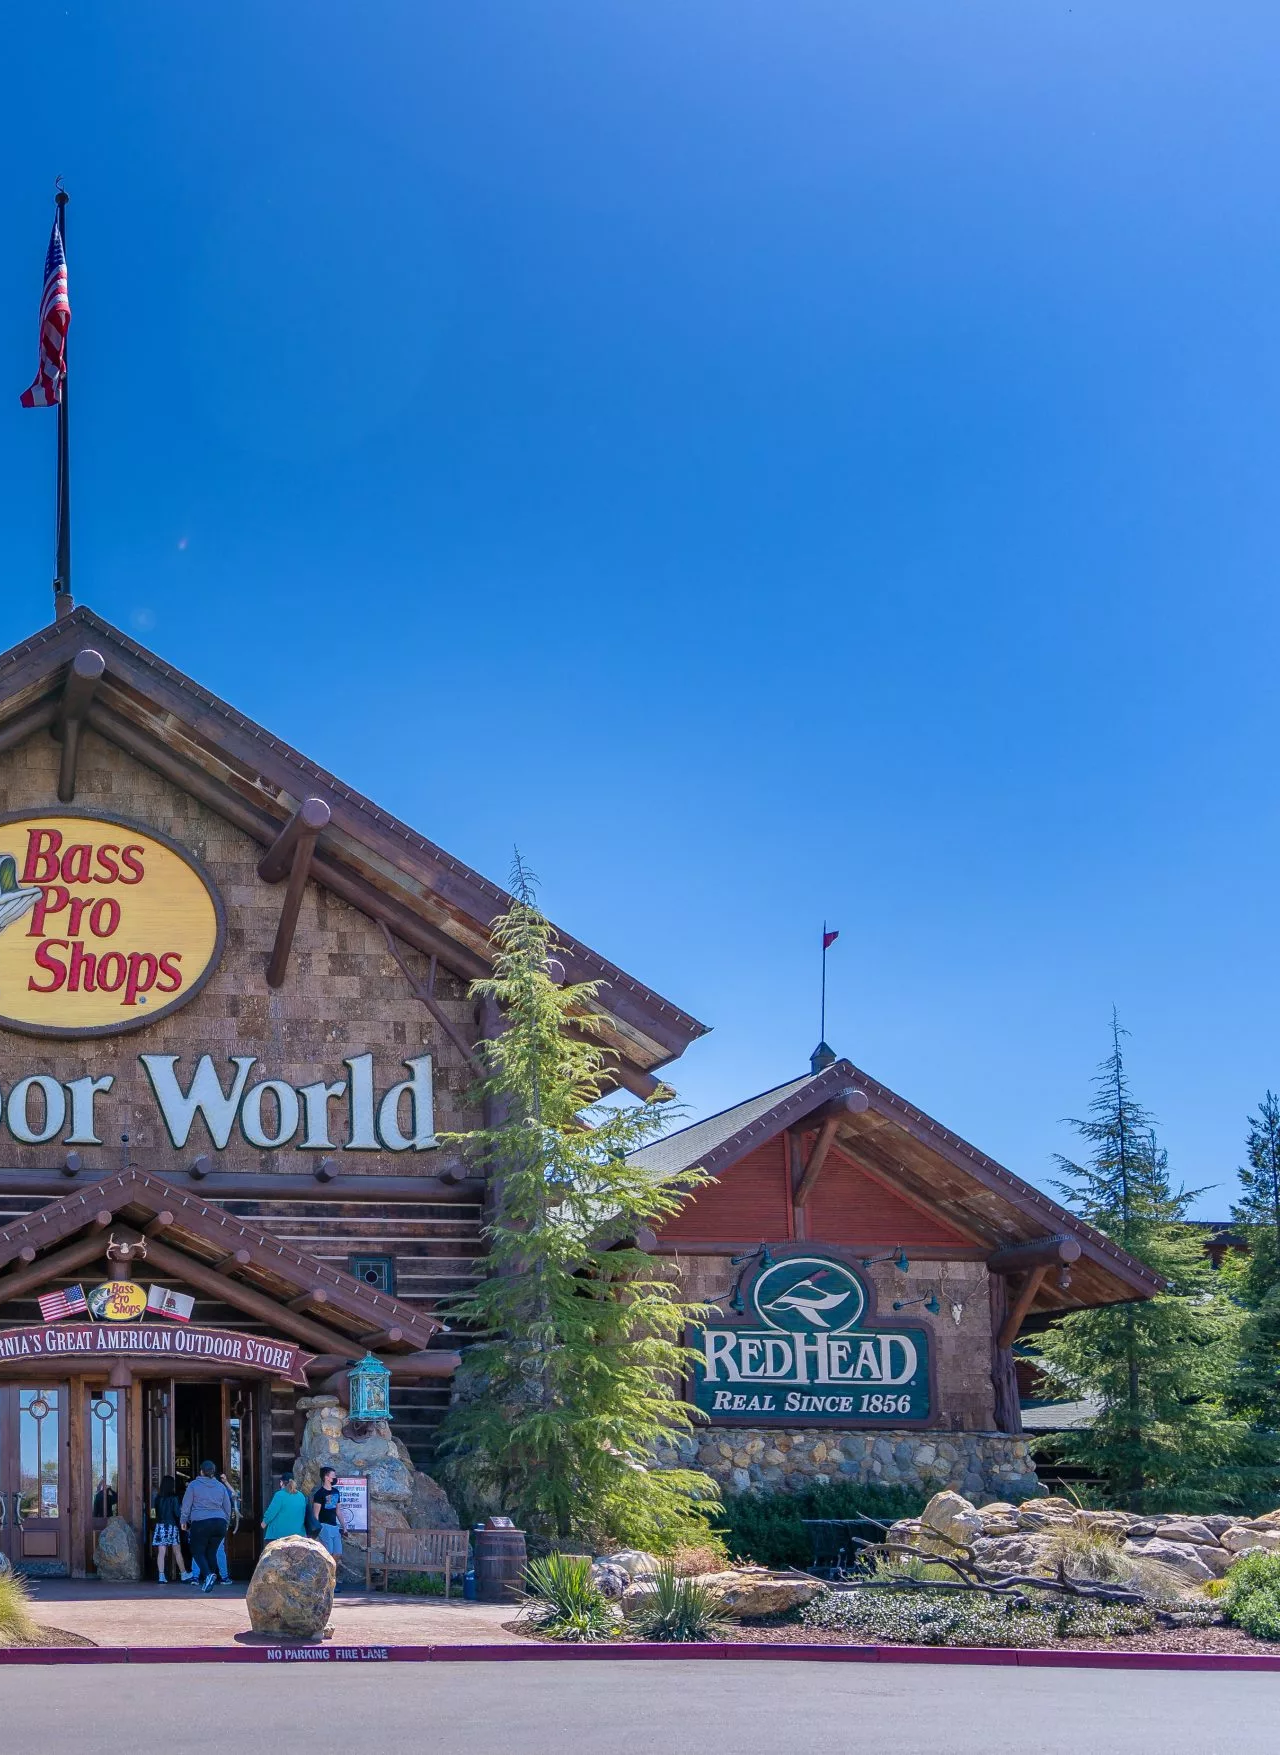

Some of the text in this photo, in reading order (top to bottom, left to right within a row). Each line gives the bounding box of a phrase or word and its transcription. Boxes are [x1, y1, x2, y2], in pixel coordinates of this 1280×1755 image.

[18, 828, 145, 884] Bass
[25, 885, 121, 938] Pro
[27, 938, 183, 1006] Shops
[138, 1052, 440, 1152] World
[111, 1283, 135, 1294] Bass
[111, 1293, 130, 1304] Pro
[112, 1303, 141, 1316] Shops
[45, 1330, 93, 1351] GREAT
[96, 1328, 172, 1351] AMERICAN
[175, 1330, 242, 1361] OUTDOOR
[245, 1339, 293, 1369] STORE
[702, 1331, 918, 1385] REDHEAD
[712, 1391, 911, 1413] REAL SINCE 1856
[267, 1649, 388, 1660] NO PARKING FIRE LANE
